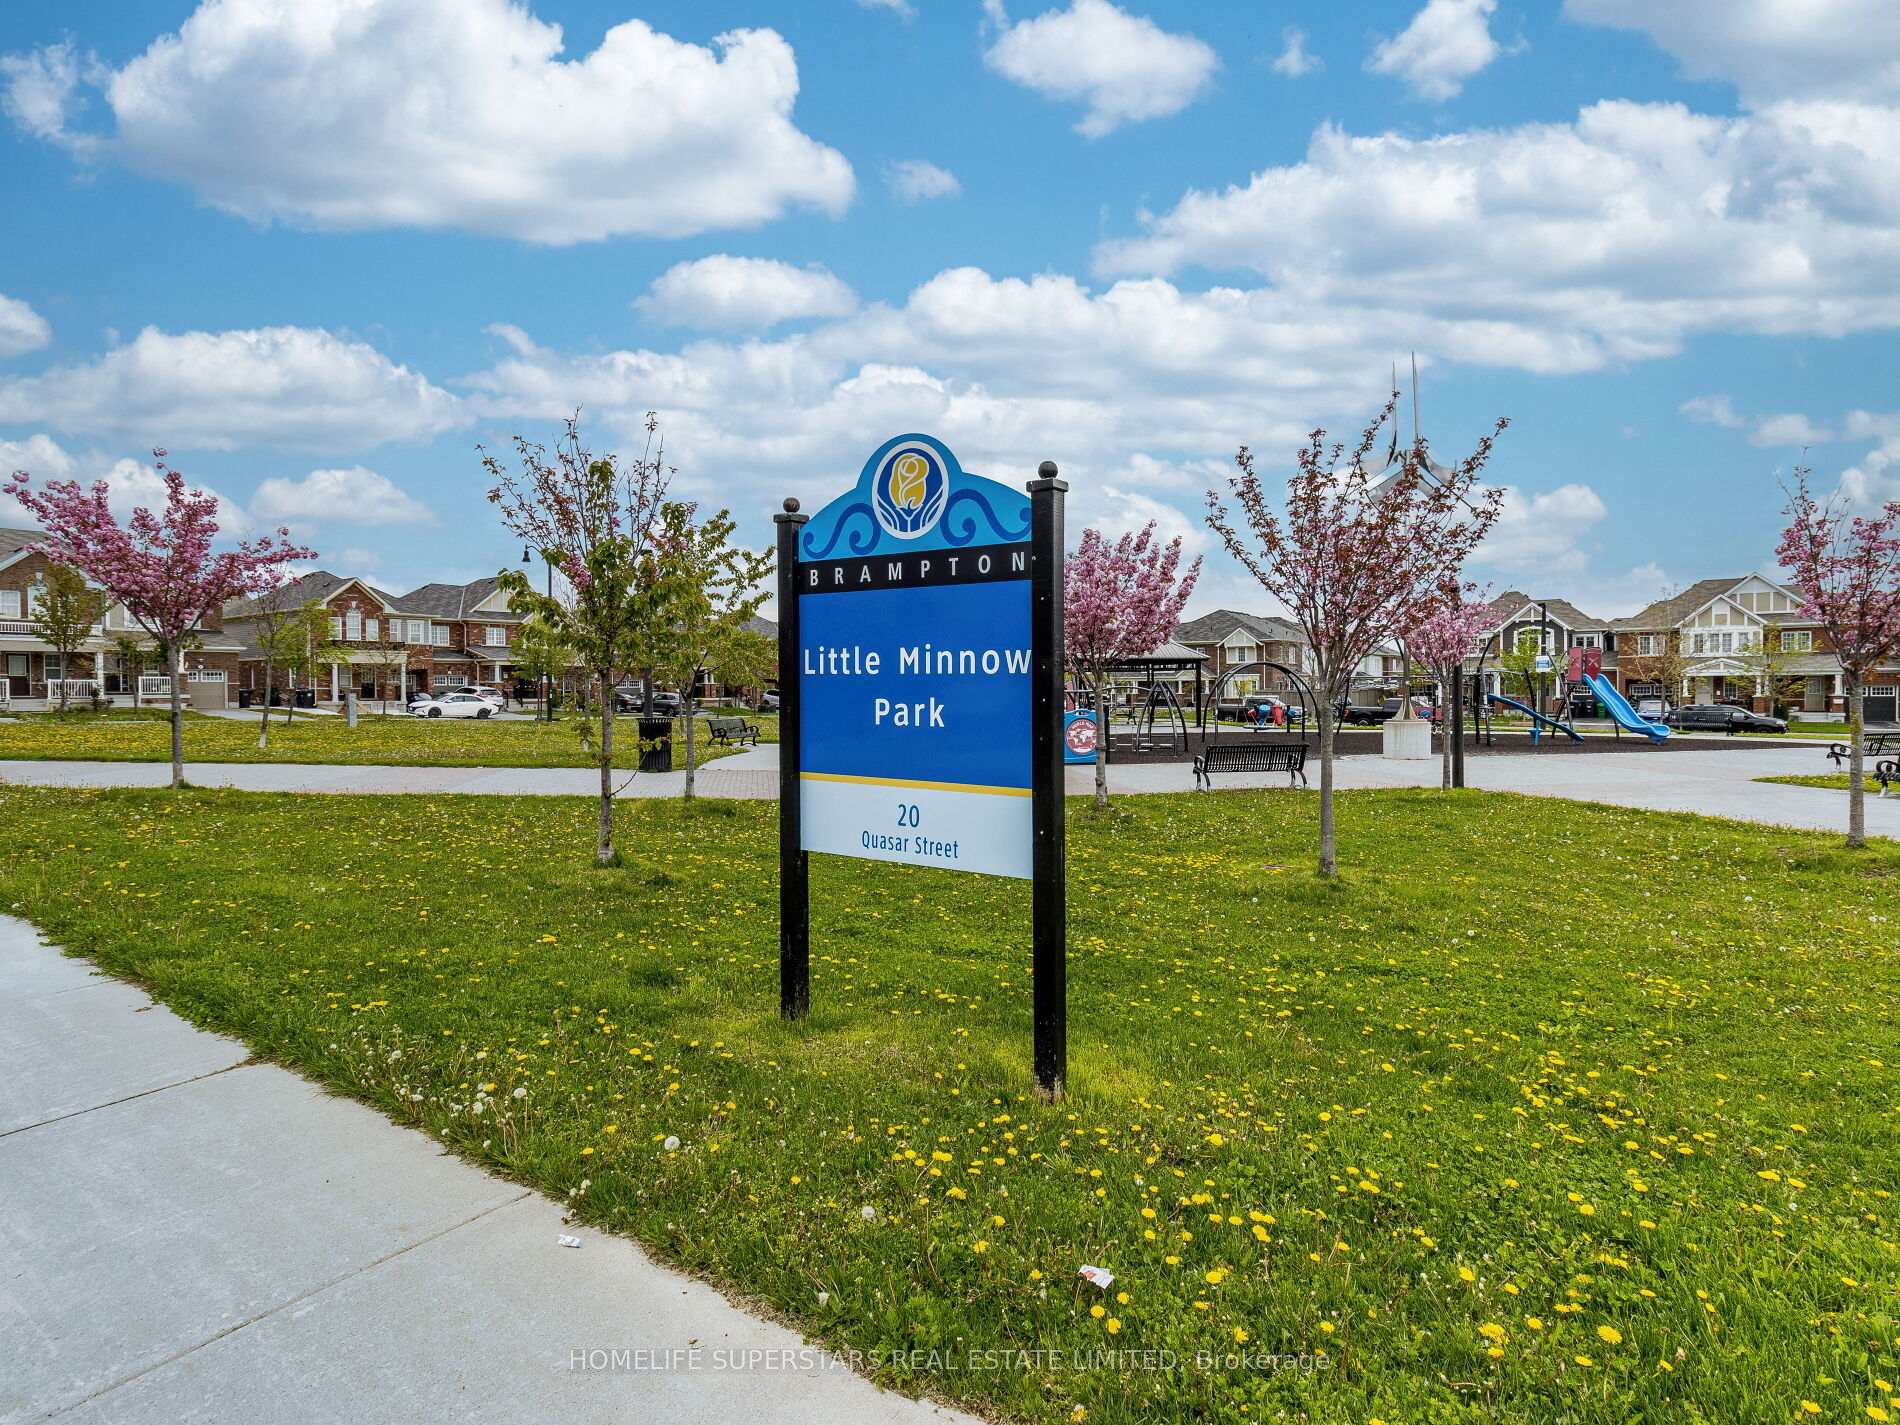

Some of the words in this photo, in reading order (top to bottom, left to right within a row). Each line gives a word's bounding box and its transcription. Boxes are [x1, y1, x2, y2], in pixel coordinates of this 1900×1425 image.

[810, 551, 1025, 586] BRAMPTON
[804, 645, 881, 675] Little
[899, 643, 1032, 675] Minnow
[874, 696, 945, 727] Park
[897, 803, 920, 828] 20
[861, 830, 909, 852] Quasar
[914, 836, 959, 859] Street
